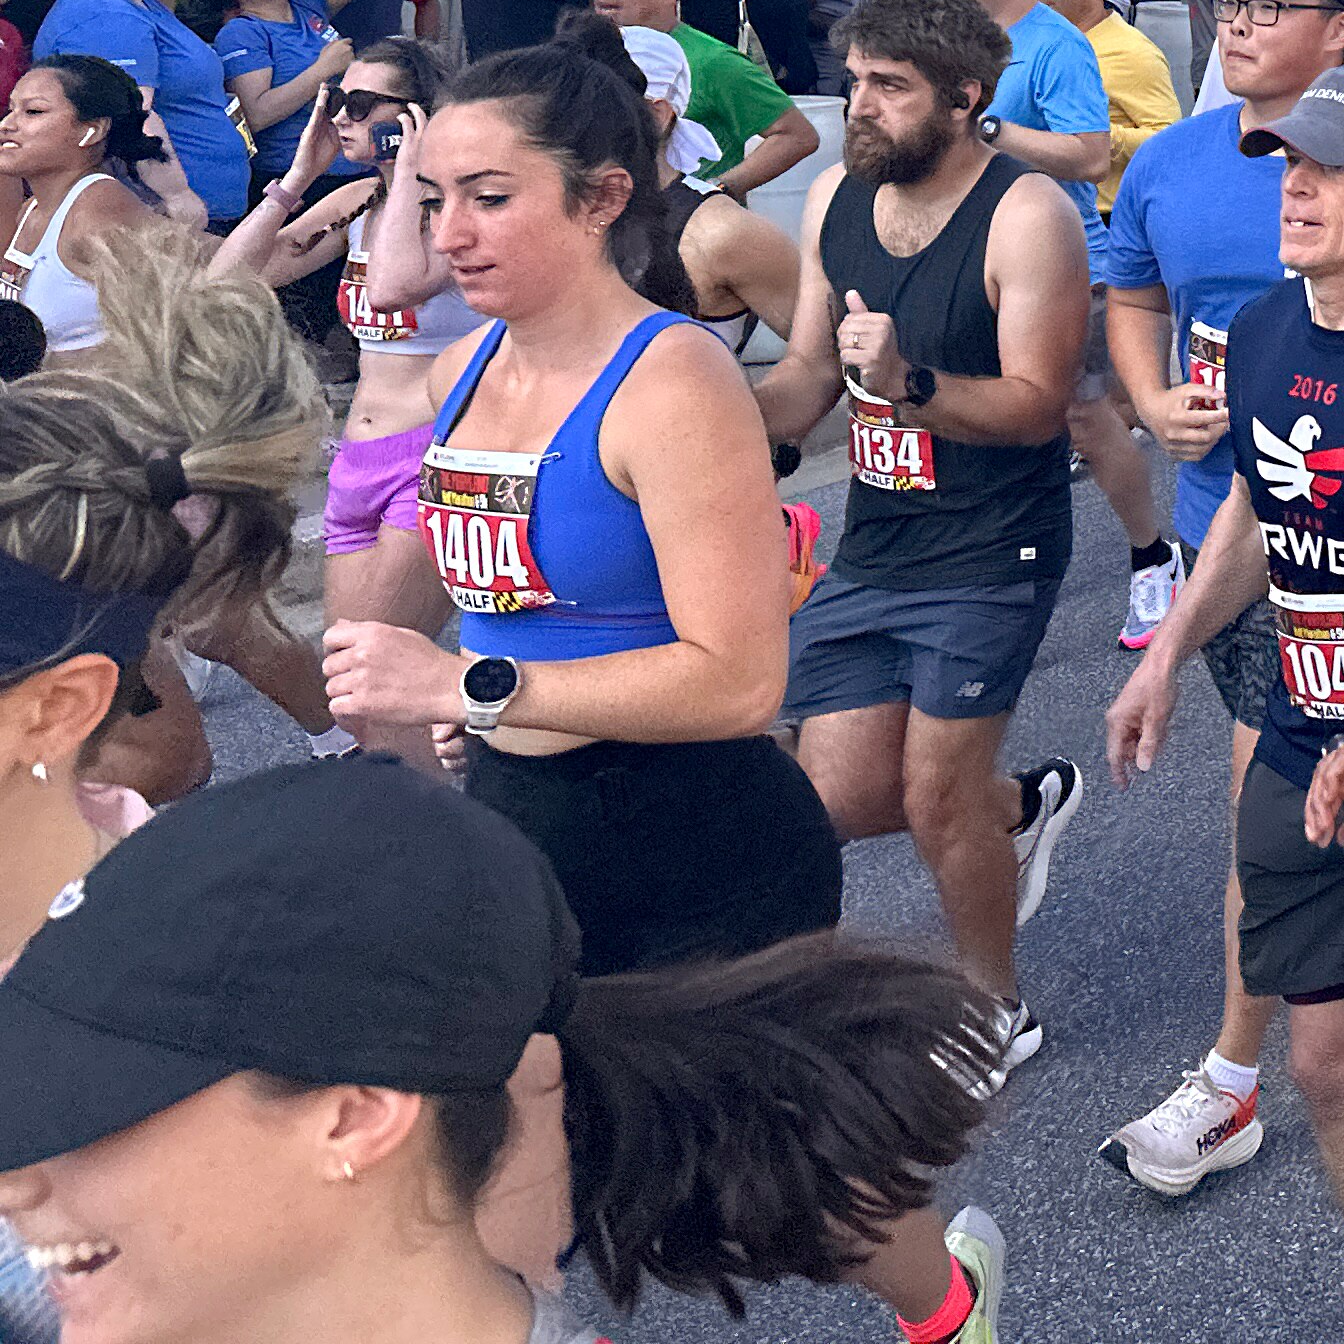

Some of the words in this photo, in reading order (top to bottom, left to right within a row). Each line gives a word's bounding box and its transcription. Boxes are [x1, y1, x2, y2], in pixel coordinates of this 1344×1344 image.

[357, 327, 381, 338] HALF
[1288, 373, 1339, 406] 2016
[851, 421, 924, 475] 1134
[863, 470, 892, 487] HALF
[427, 510, 530, 589] 1404
[455, 588, 491, 609] HALF
